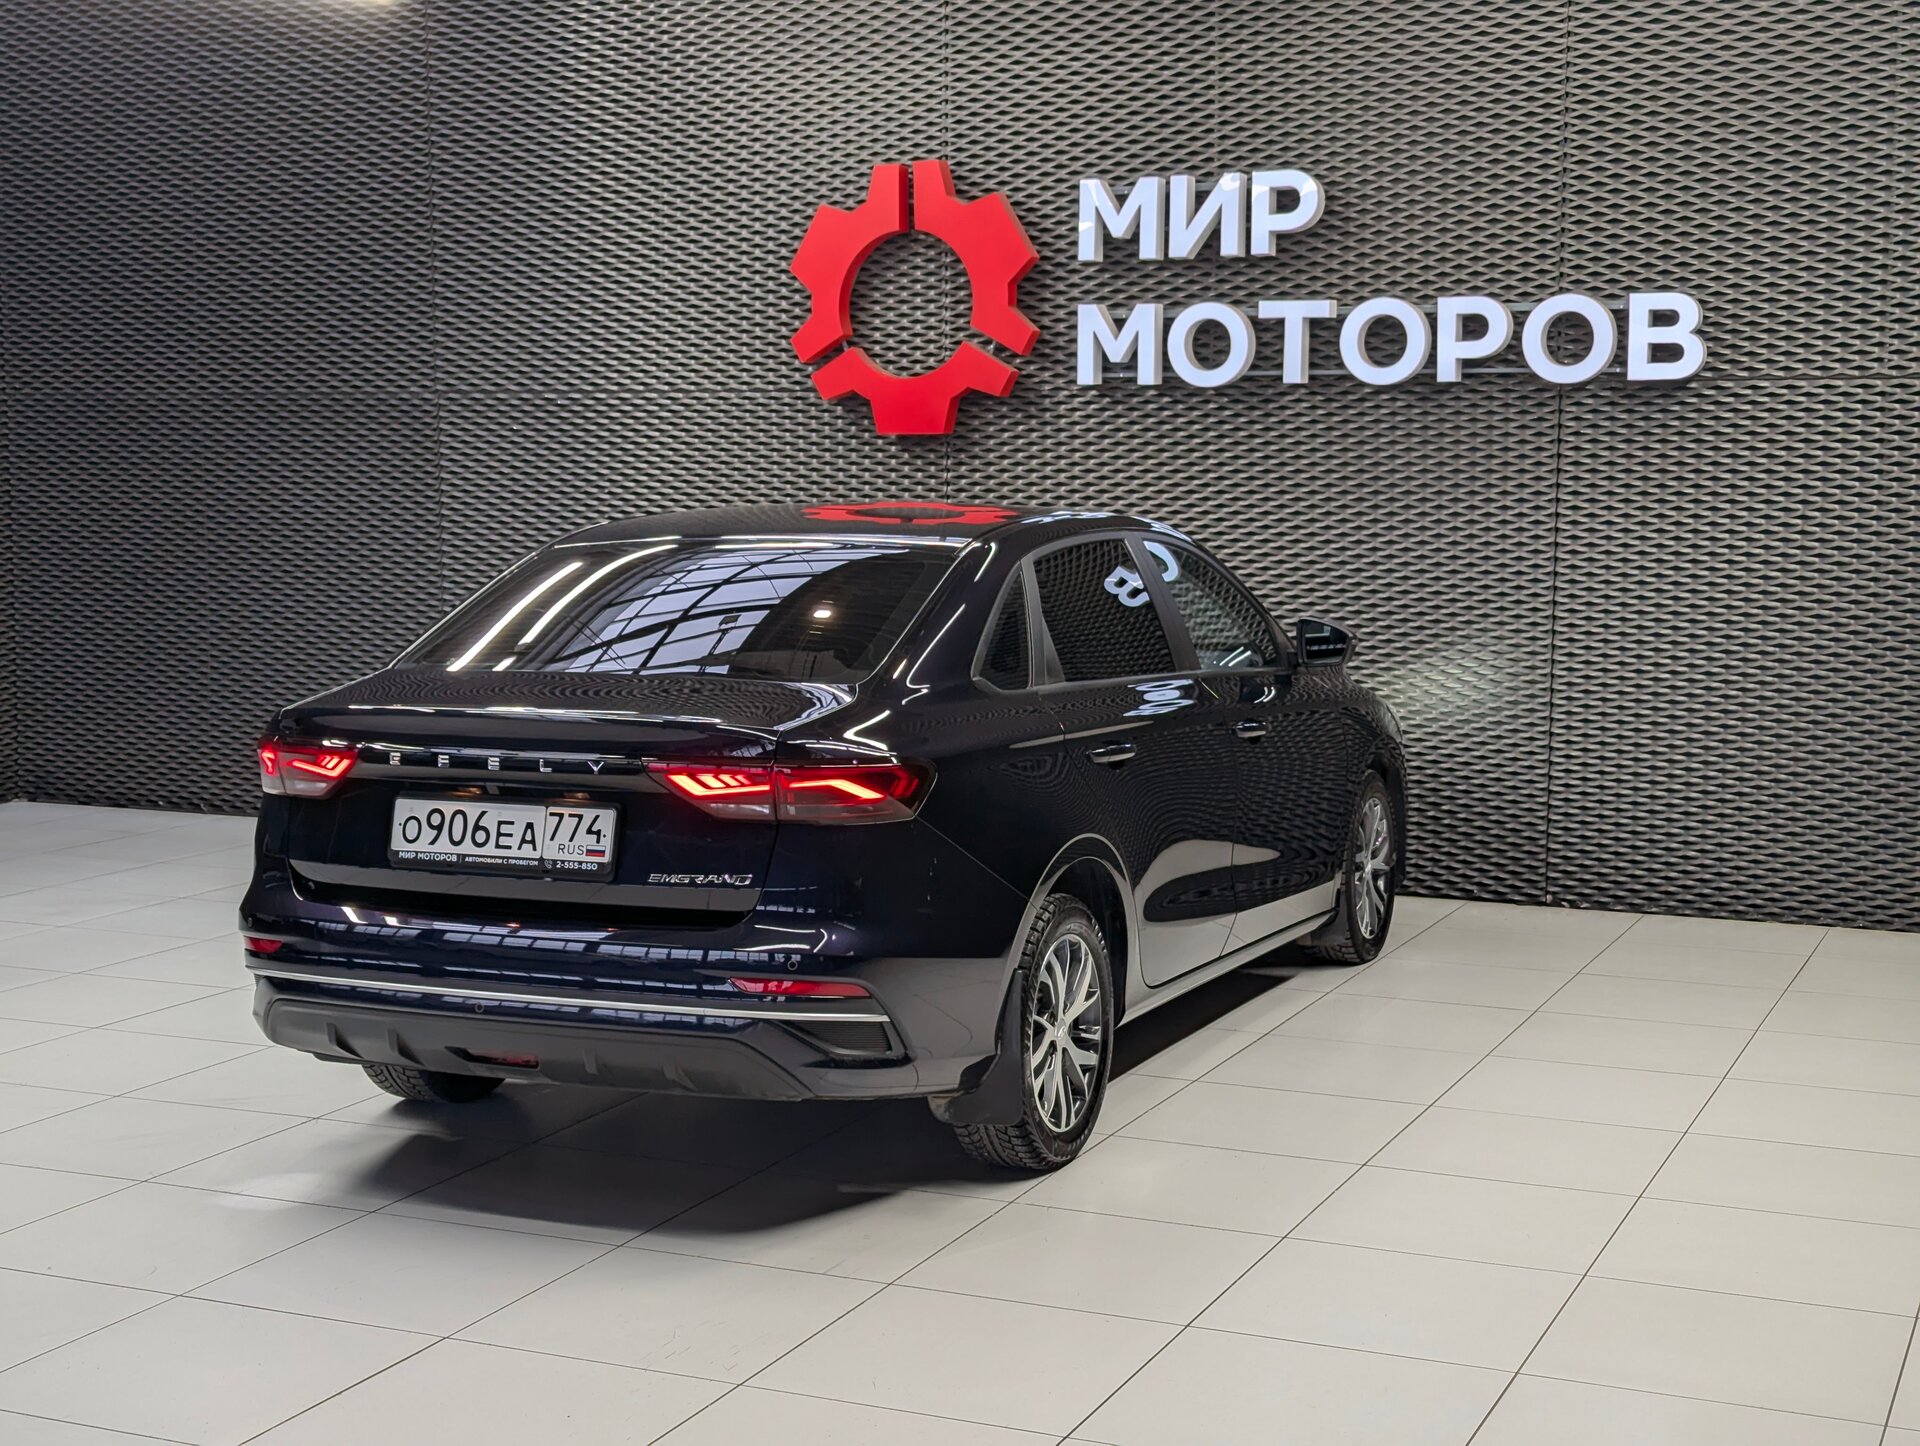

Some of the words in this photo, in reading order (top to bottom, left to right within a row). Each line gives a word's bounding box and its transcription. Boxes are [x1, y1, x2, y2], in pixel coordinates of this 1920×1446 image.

[1076, 168, 1325, 262] МИР
[1076, 292, 1707, 387] МОТОРОВ
[548, 812, 602, 845] 774
[557, 843, 585, 856] RUS
[398, 851, 416, 859] МИР
[417, 852, 458, 862] МОТОРОВ
[464, 856, 503, 864] АВТОМОБИЛИ
[555, 861, 598, 871] 2-555-850
[648, 873, 753, 886] EMGRAND
